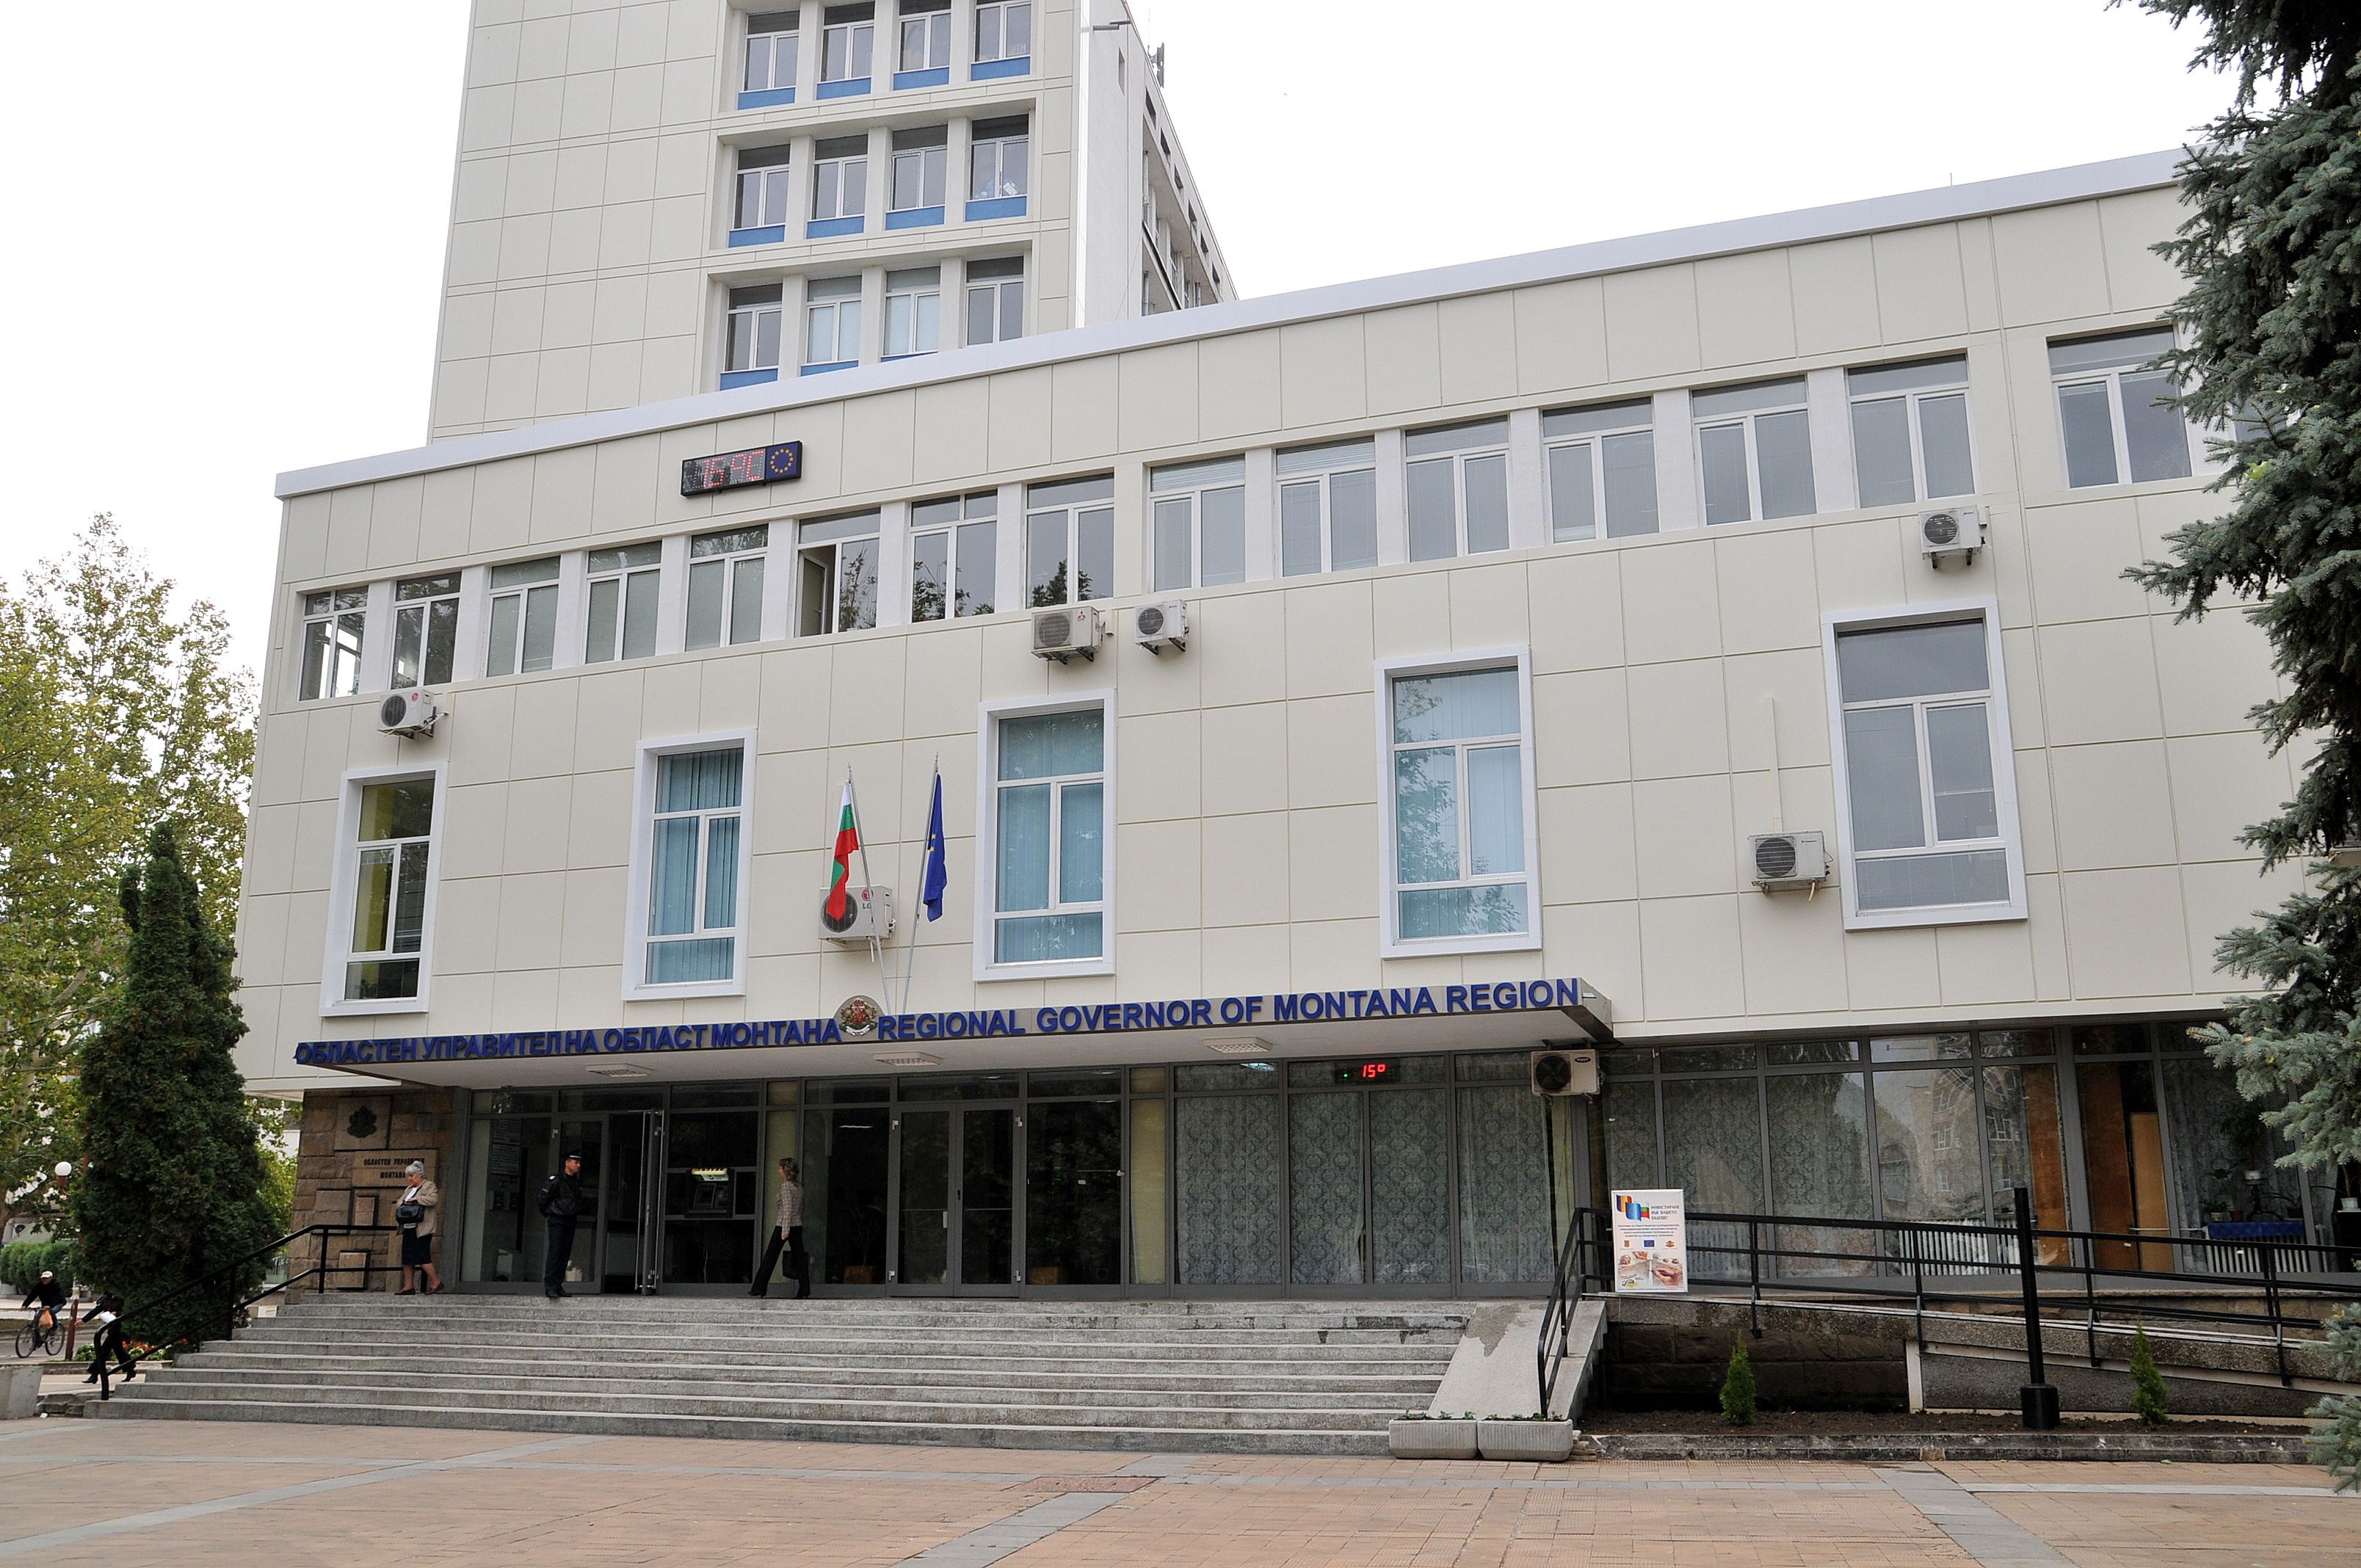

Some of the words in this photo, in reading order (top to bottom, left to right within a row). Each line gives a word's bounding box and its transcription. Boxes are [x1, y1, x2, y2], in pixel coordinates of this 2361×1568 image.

[878, 1009, 1026, 1039] REGIONAL
[1037, 998, 1213, 1031] GOVERNOR
[1220, 995, 1263, 1023] OF
[1274, 987, 1437, 1020] MONTANA
[1446, 978, 1578, 1012] REGION
[295, 1039, 418, 1064] ОБЛАСТЕН
[422, 1031, 562, 1059] УПРАВИТЕЛ
[565, 1029, 600, 1053] НА
[603, 1024, 708, 1052] ОБЛАСТ
[711, 1018, 841, 1046] МОНТАНА
